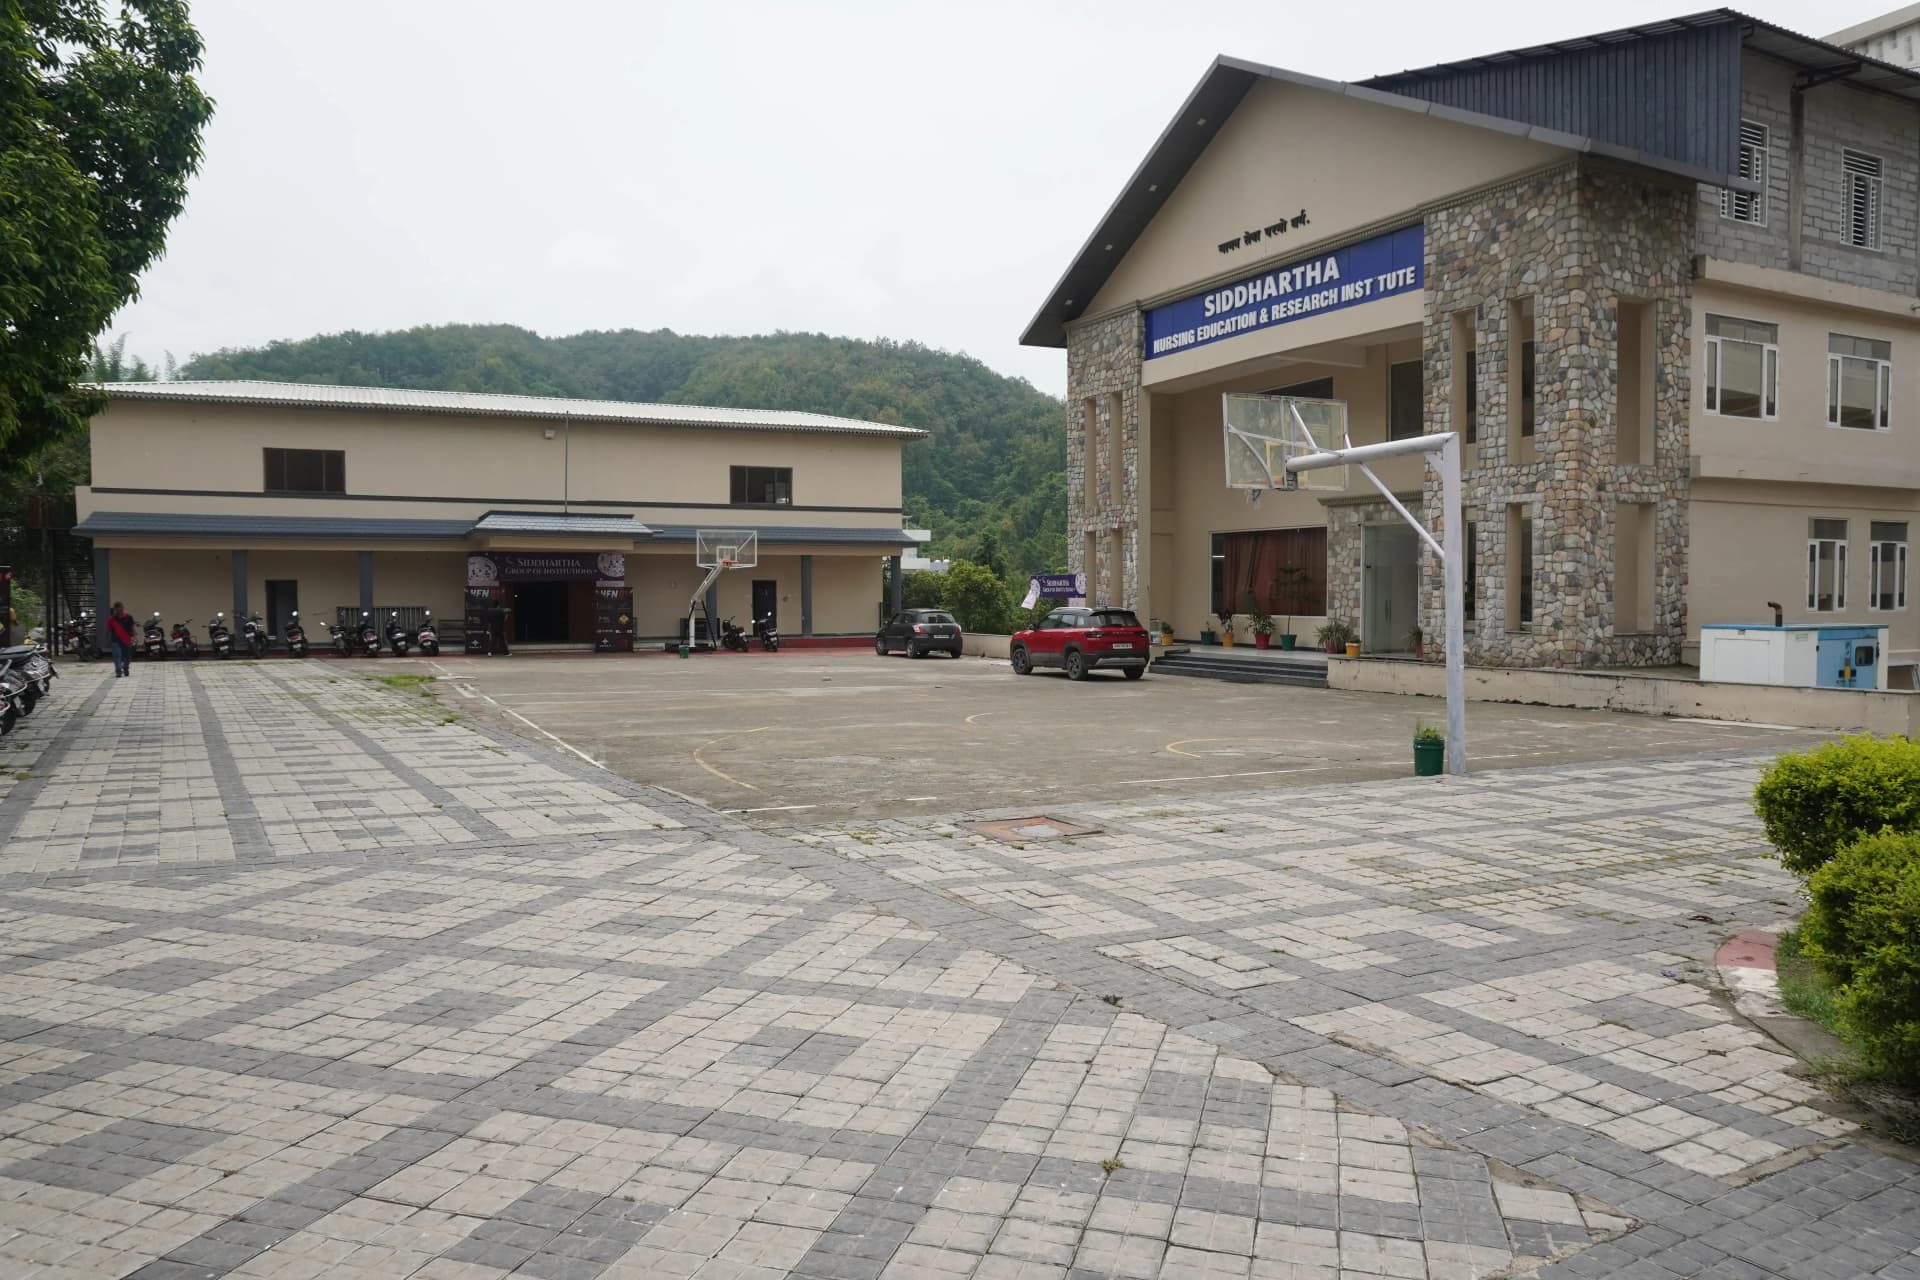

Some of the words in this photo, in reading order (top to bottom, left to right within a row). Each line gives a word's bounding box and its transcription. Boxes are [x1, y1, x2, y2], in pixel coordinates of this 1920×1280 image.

[1204, 256, 1340, 318] SIDDHARTHA
[1153, 329, 1196, 354] NURSING
[1197, 311, 1257, 342] EDUCATION
[1259, 307, 1269, 324] &
[1271, 287, 1339, 321] RESEARCH
[518, 559, 581, 567] SIDDHARTHA
